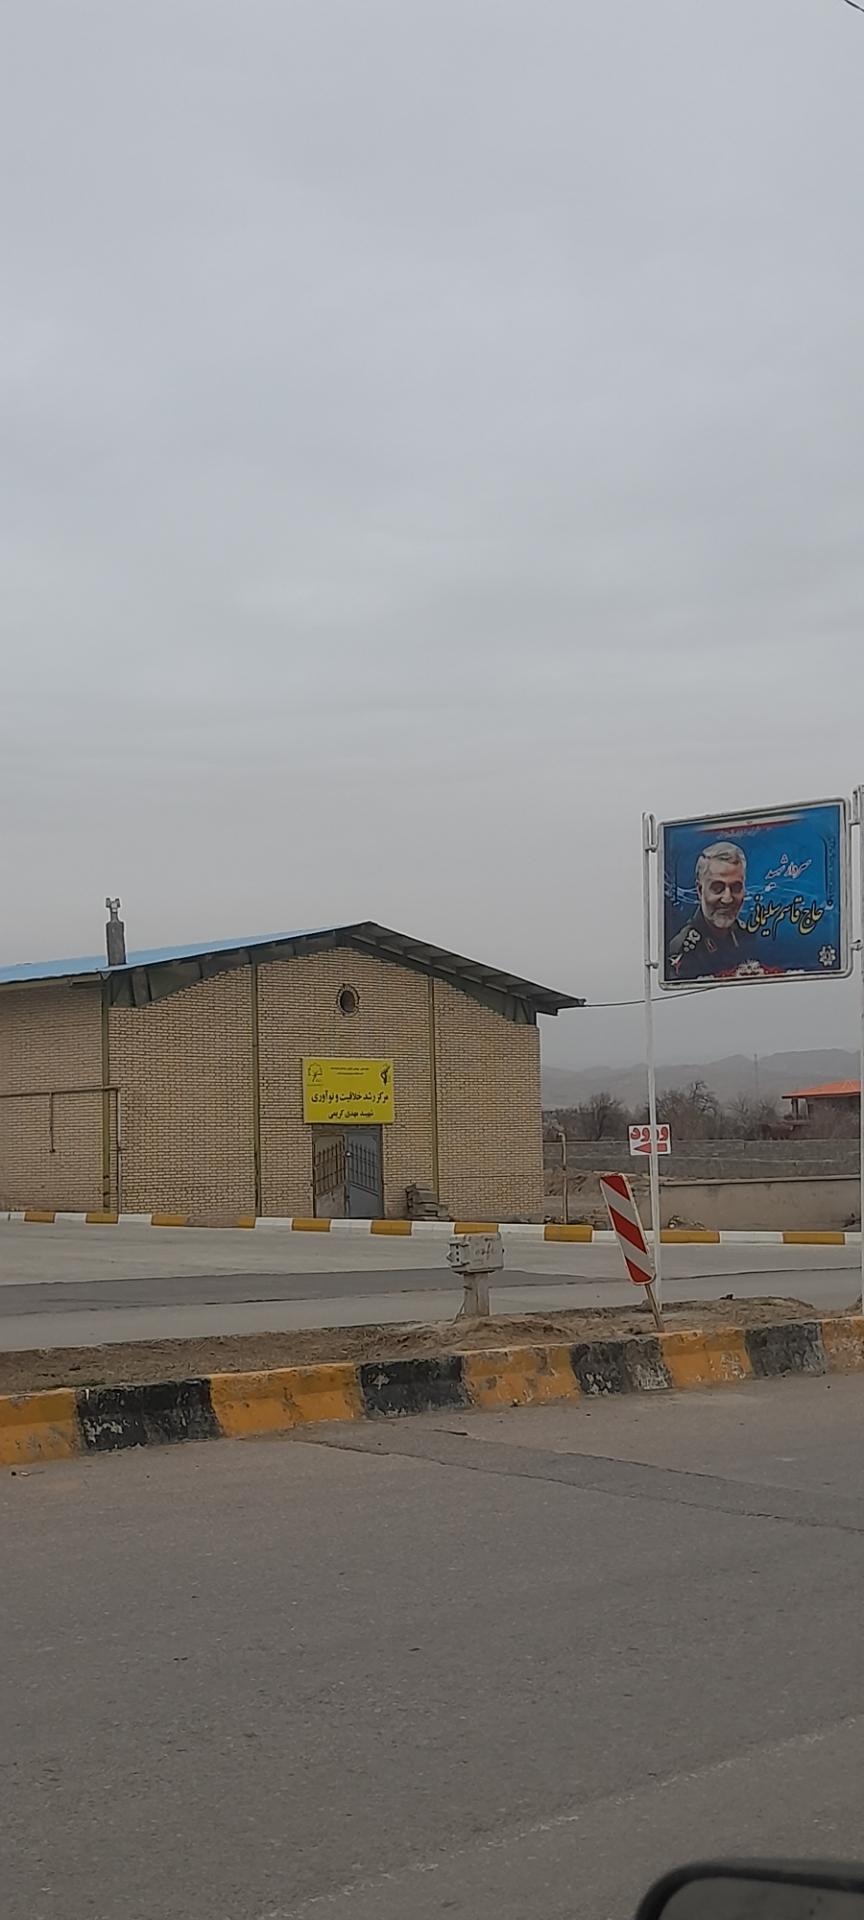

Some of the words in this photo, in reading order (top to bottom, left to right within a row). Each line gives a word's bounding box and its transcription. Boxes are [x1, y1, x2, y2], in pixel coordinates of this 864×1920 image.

[764, 853, 789, 891] شهید
[784, 858, 812, 879] سردار
[747, 896, 781, 936] سلیمانی
[773, 896, 803, 941] قاسم
[799, 899, 824, 935] حاج
[339, 1091, 362, 1103] خلاقیت
[363, 1091, 376, 1103] رشد
[376, 1091, 389, 1103] مرکز
[344, 1111, 359, 1119] مهدی
[360, 1109, 374, 1118] شهید
[630, 1126, 669, 1142] وود
